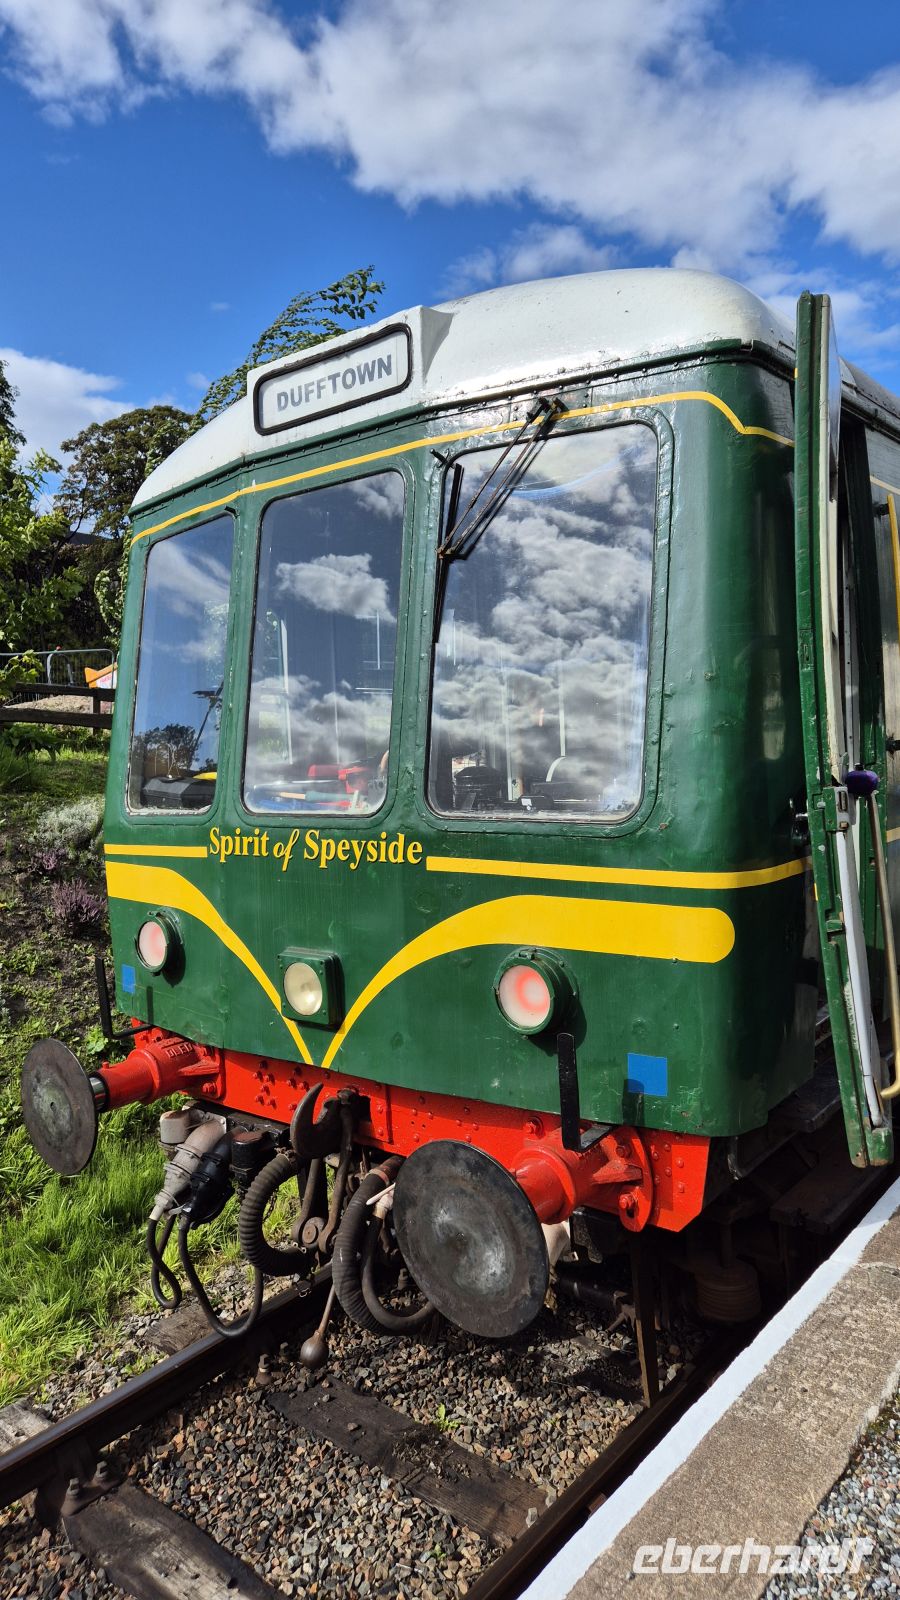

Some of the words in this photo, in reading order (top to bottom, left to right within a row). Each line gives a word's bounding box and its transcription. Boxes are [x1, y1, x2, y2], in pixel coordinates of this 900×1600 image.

[276, 354, 392, 412] DUFFTOWN
[209, 826, 270, 863] Spirit
[273, 828, 300, 872] of
[303, 829, 423, 870] Speyside
